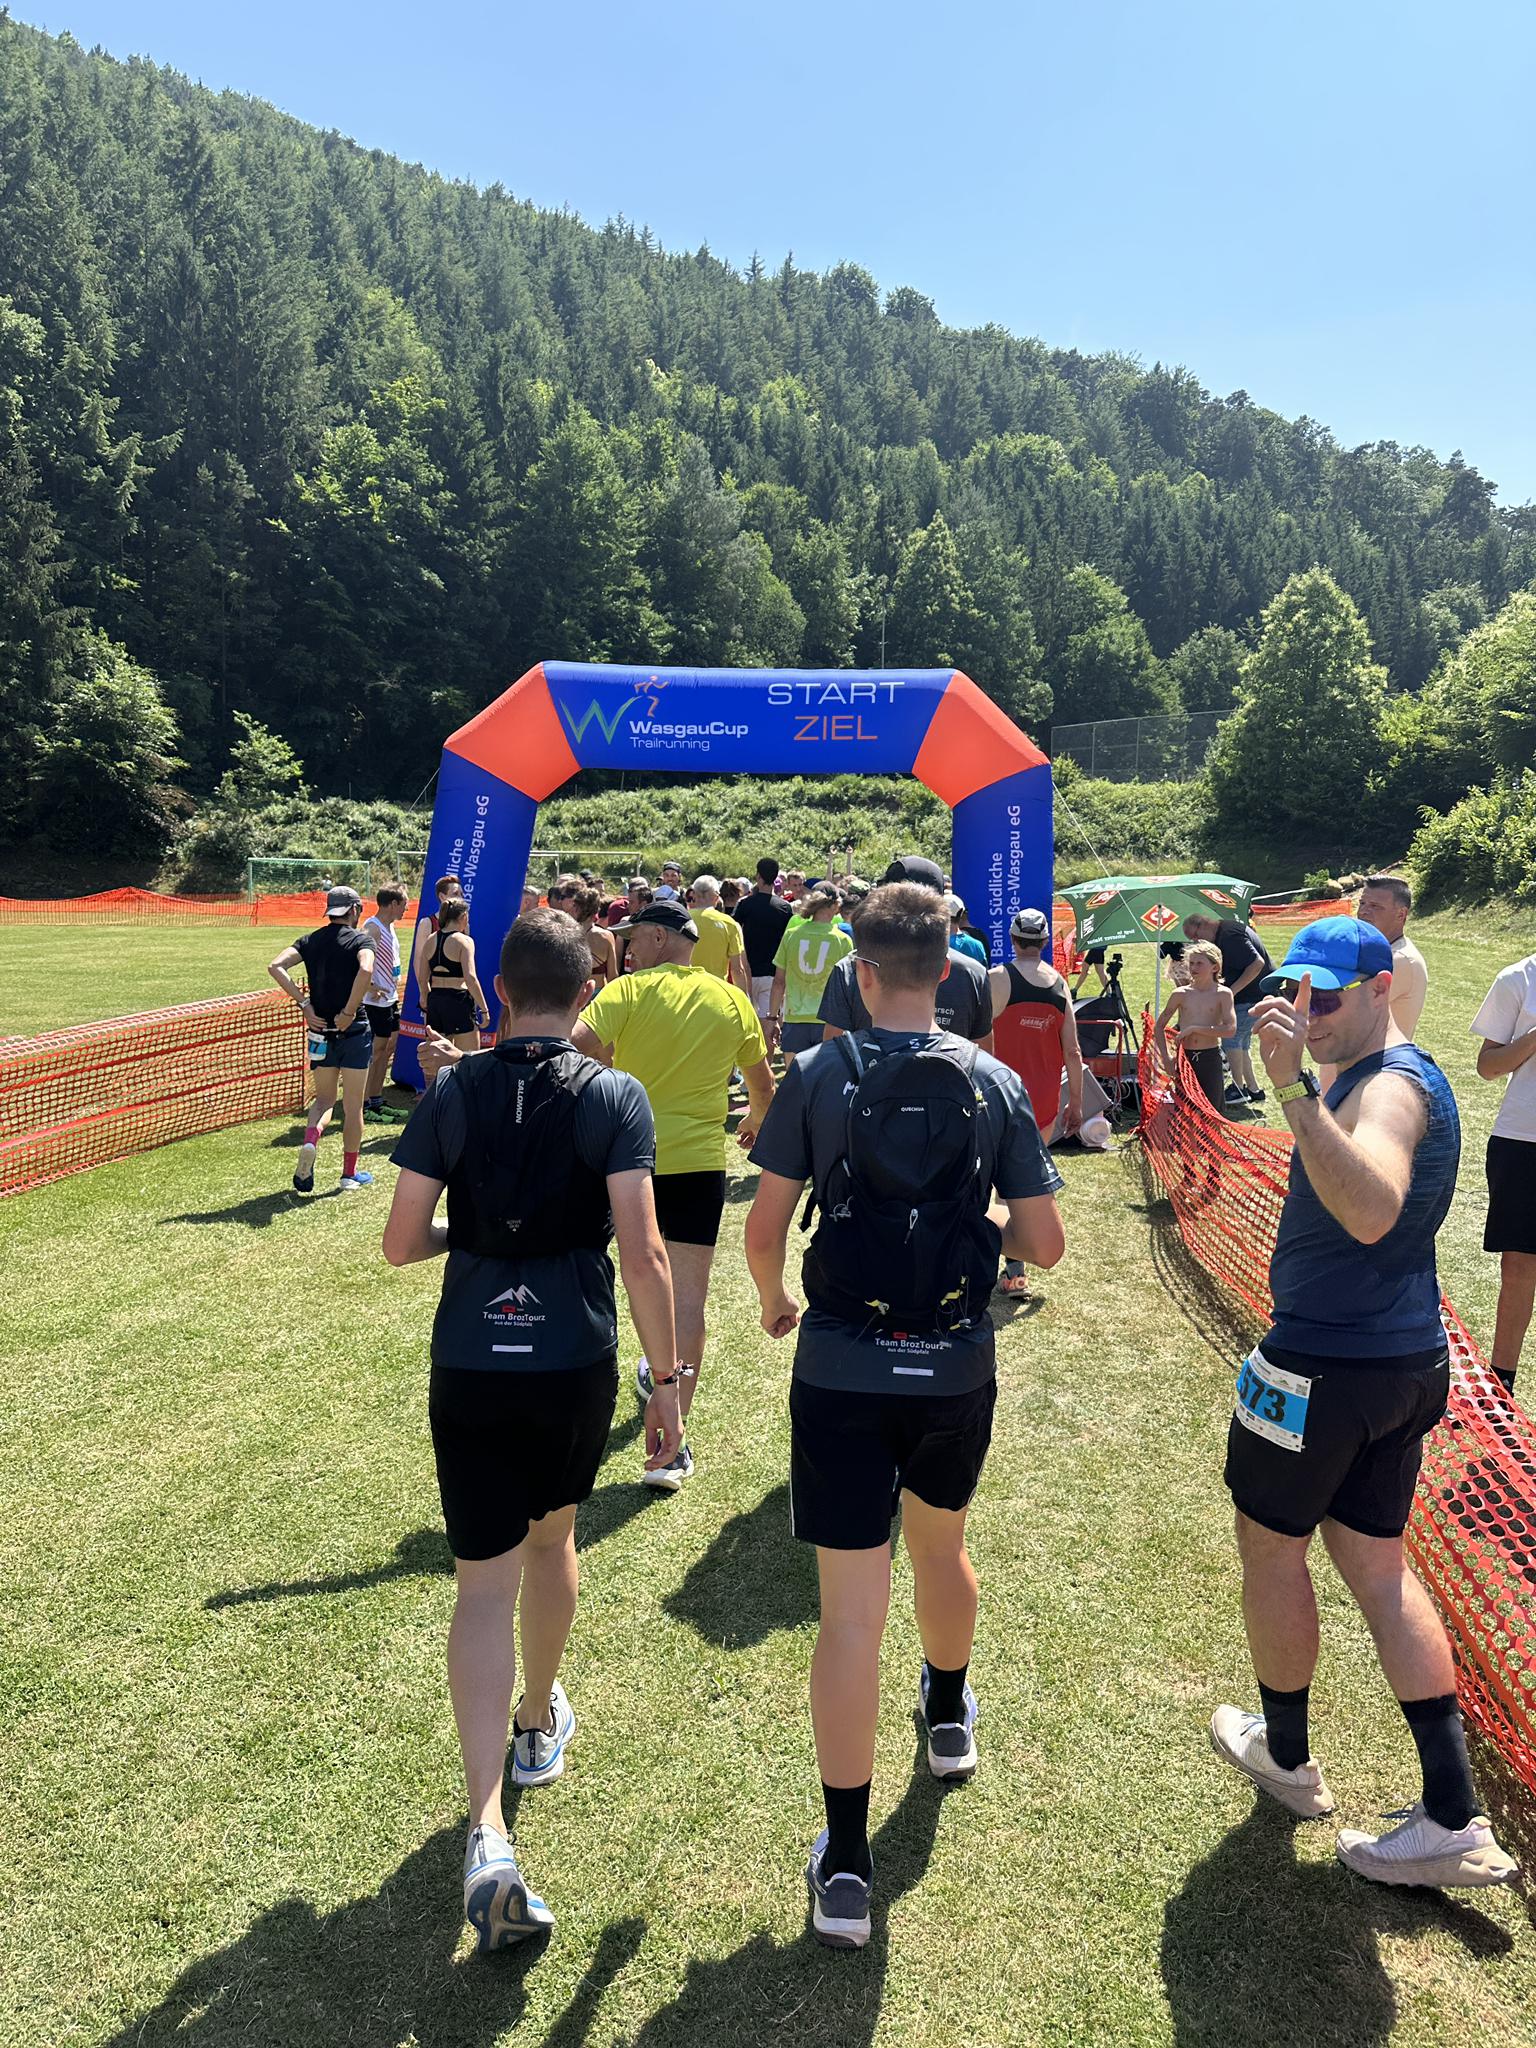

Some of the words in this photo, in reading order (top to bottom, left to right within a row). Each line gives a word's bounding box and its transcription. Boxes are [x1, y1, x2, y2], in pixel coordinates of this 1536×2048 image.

[767, 681, 905, 705] START
[629, 720, 749, 739] WasgauCup
[793, 715, 878, 741] ZIEL
[629, 736, 710, 752] Trailrunning
[475, 795, 490, 816] eG
[1008, 804, 1021, 827] eG
[988, 851, 1003, 917] Südliche
[988, 919, 1004, 960] Bank
[516, 1080, 525, 1124] SALOMON
[483, 1312, 505, 1321] Team
[874, 1338, 898, 1348] Team
